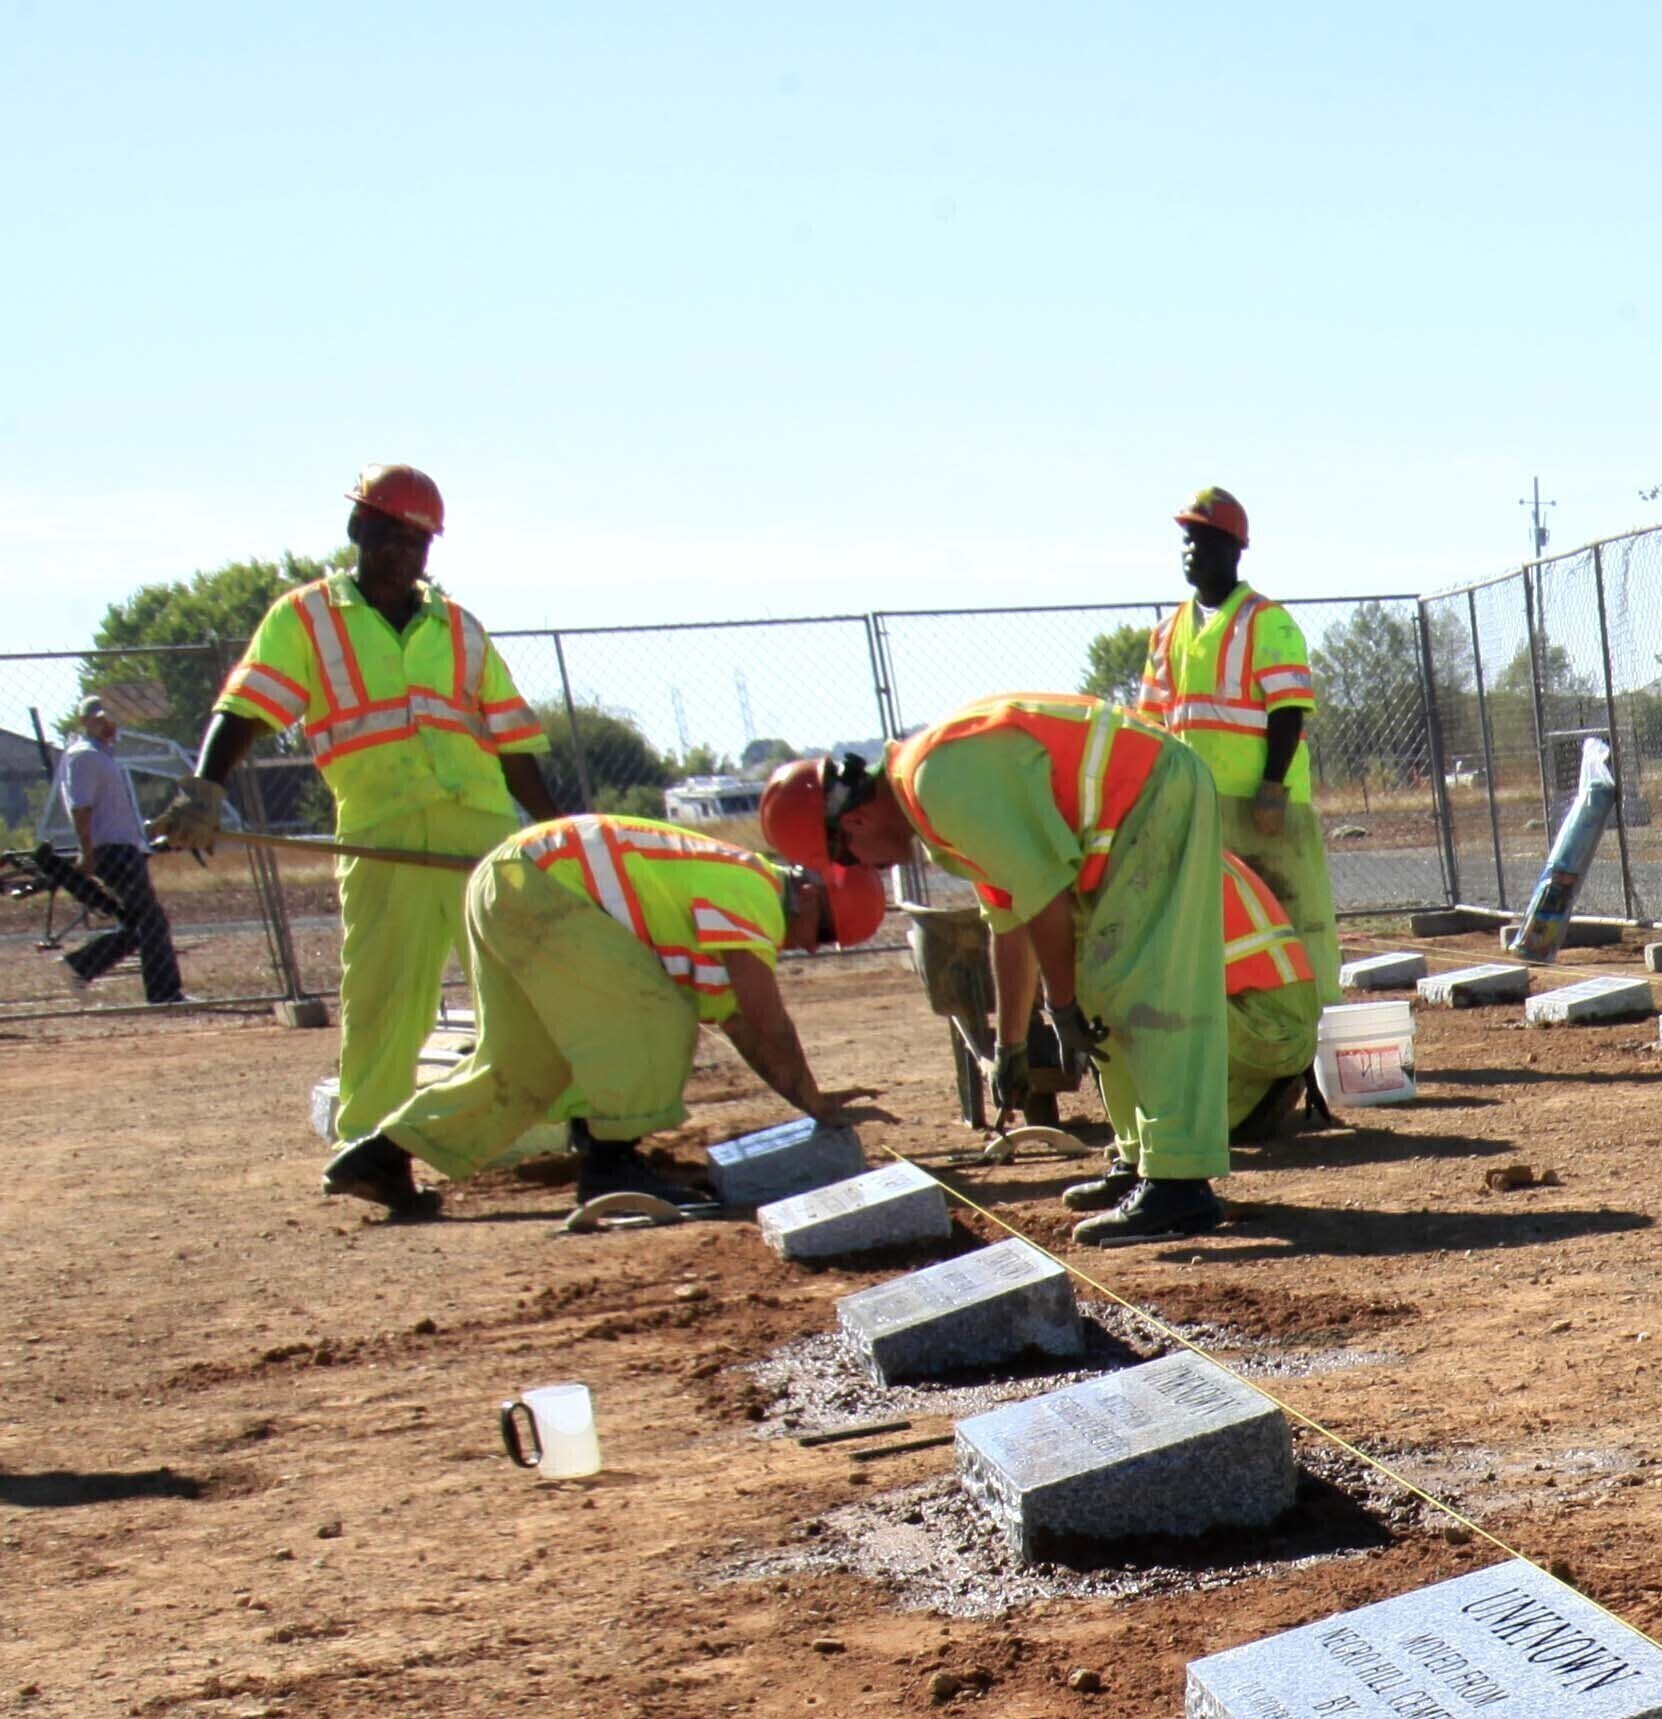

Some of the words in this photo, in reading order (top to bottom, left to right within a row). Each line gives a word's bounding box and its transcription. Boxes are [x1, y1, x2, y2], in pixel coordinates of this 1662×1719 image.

[1314, 1626, 1382, 1667] NEGRO
[1355, 1661, 1412, 1695] HILL
[1400, 1631, 1469, 1675] MOVED
[1443, 1669, 1511, 1709] FROM
[1461, 1587, 1643, 1695] UNKNOWN
[1312, 1695, 1361, 1718] BY
